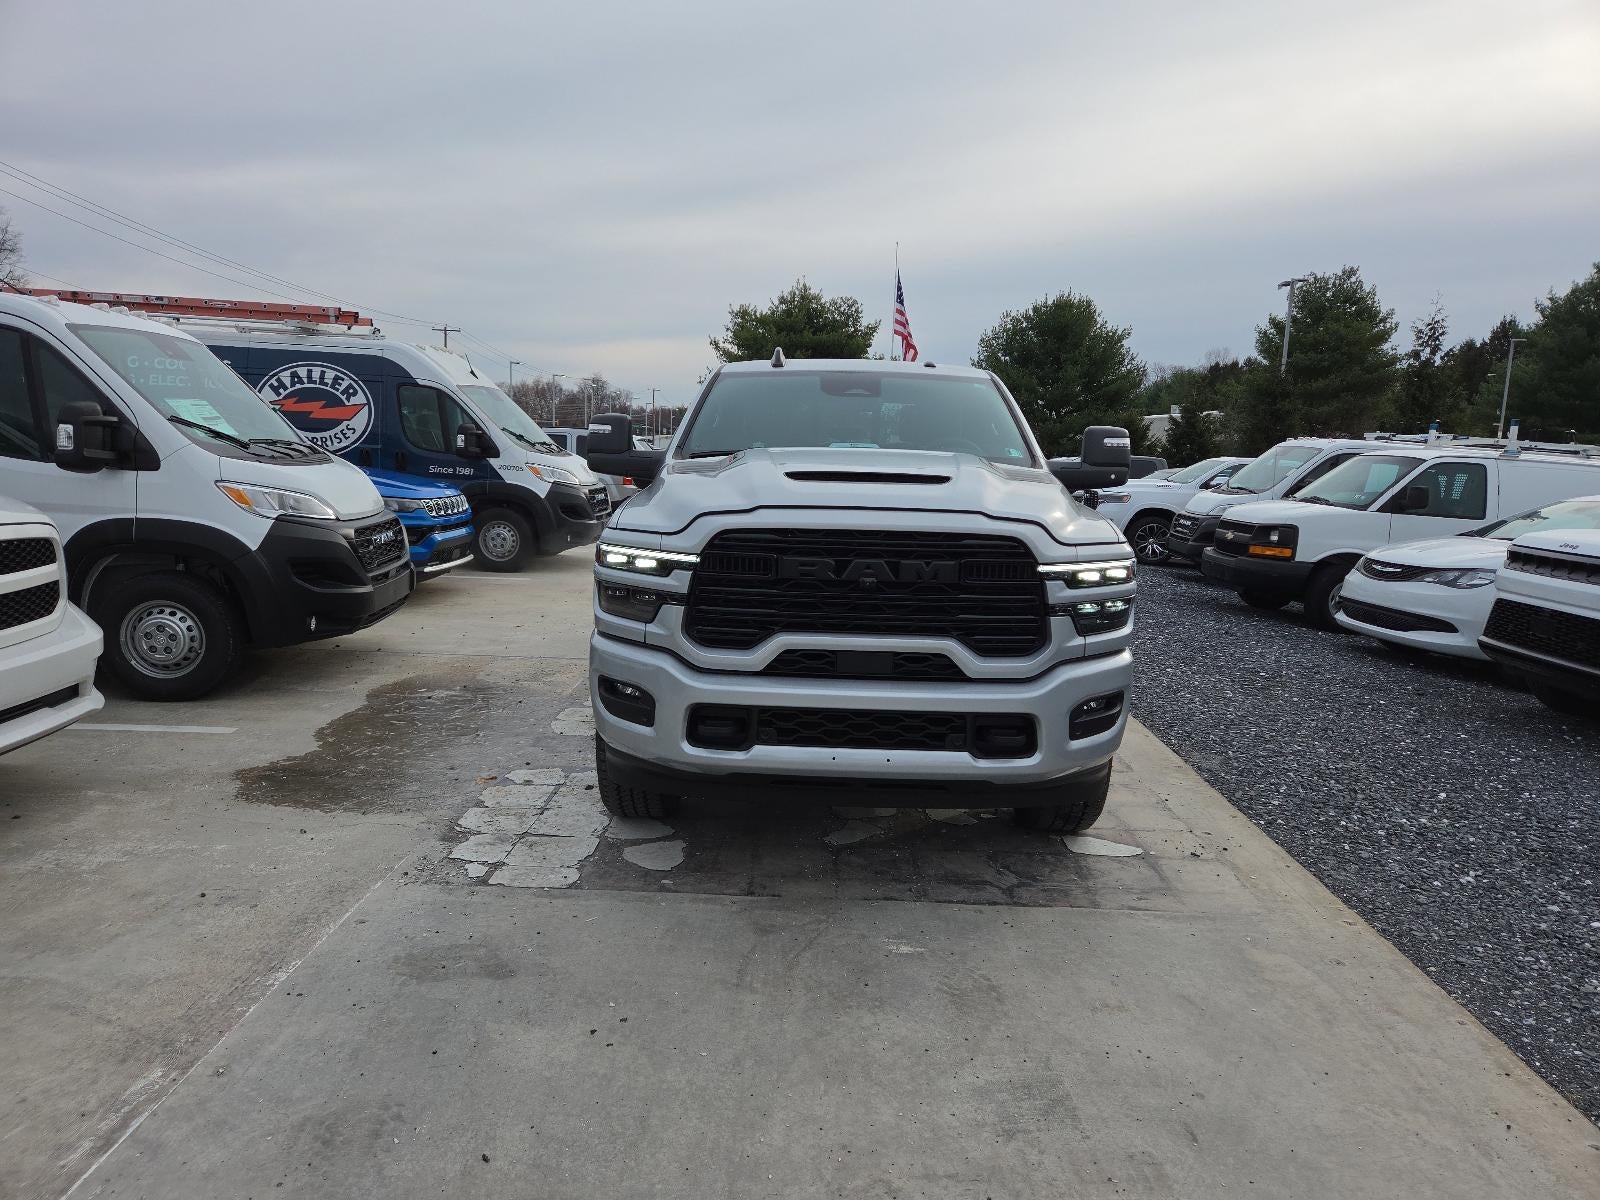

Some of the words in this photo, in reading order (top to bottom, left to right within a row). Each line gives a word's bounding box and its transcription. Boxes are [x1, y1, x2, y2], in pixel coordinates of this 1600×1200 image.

[268, 368, 359, 403] HALLER
[305, 423, 356, 447] PRISES
[428, 465, 454, 474] Since
[455, 466, 474, 476] 1981
[372, 530, 395, 546] RAM
[779, 556, 958, 583] RAM
